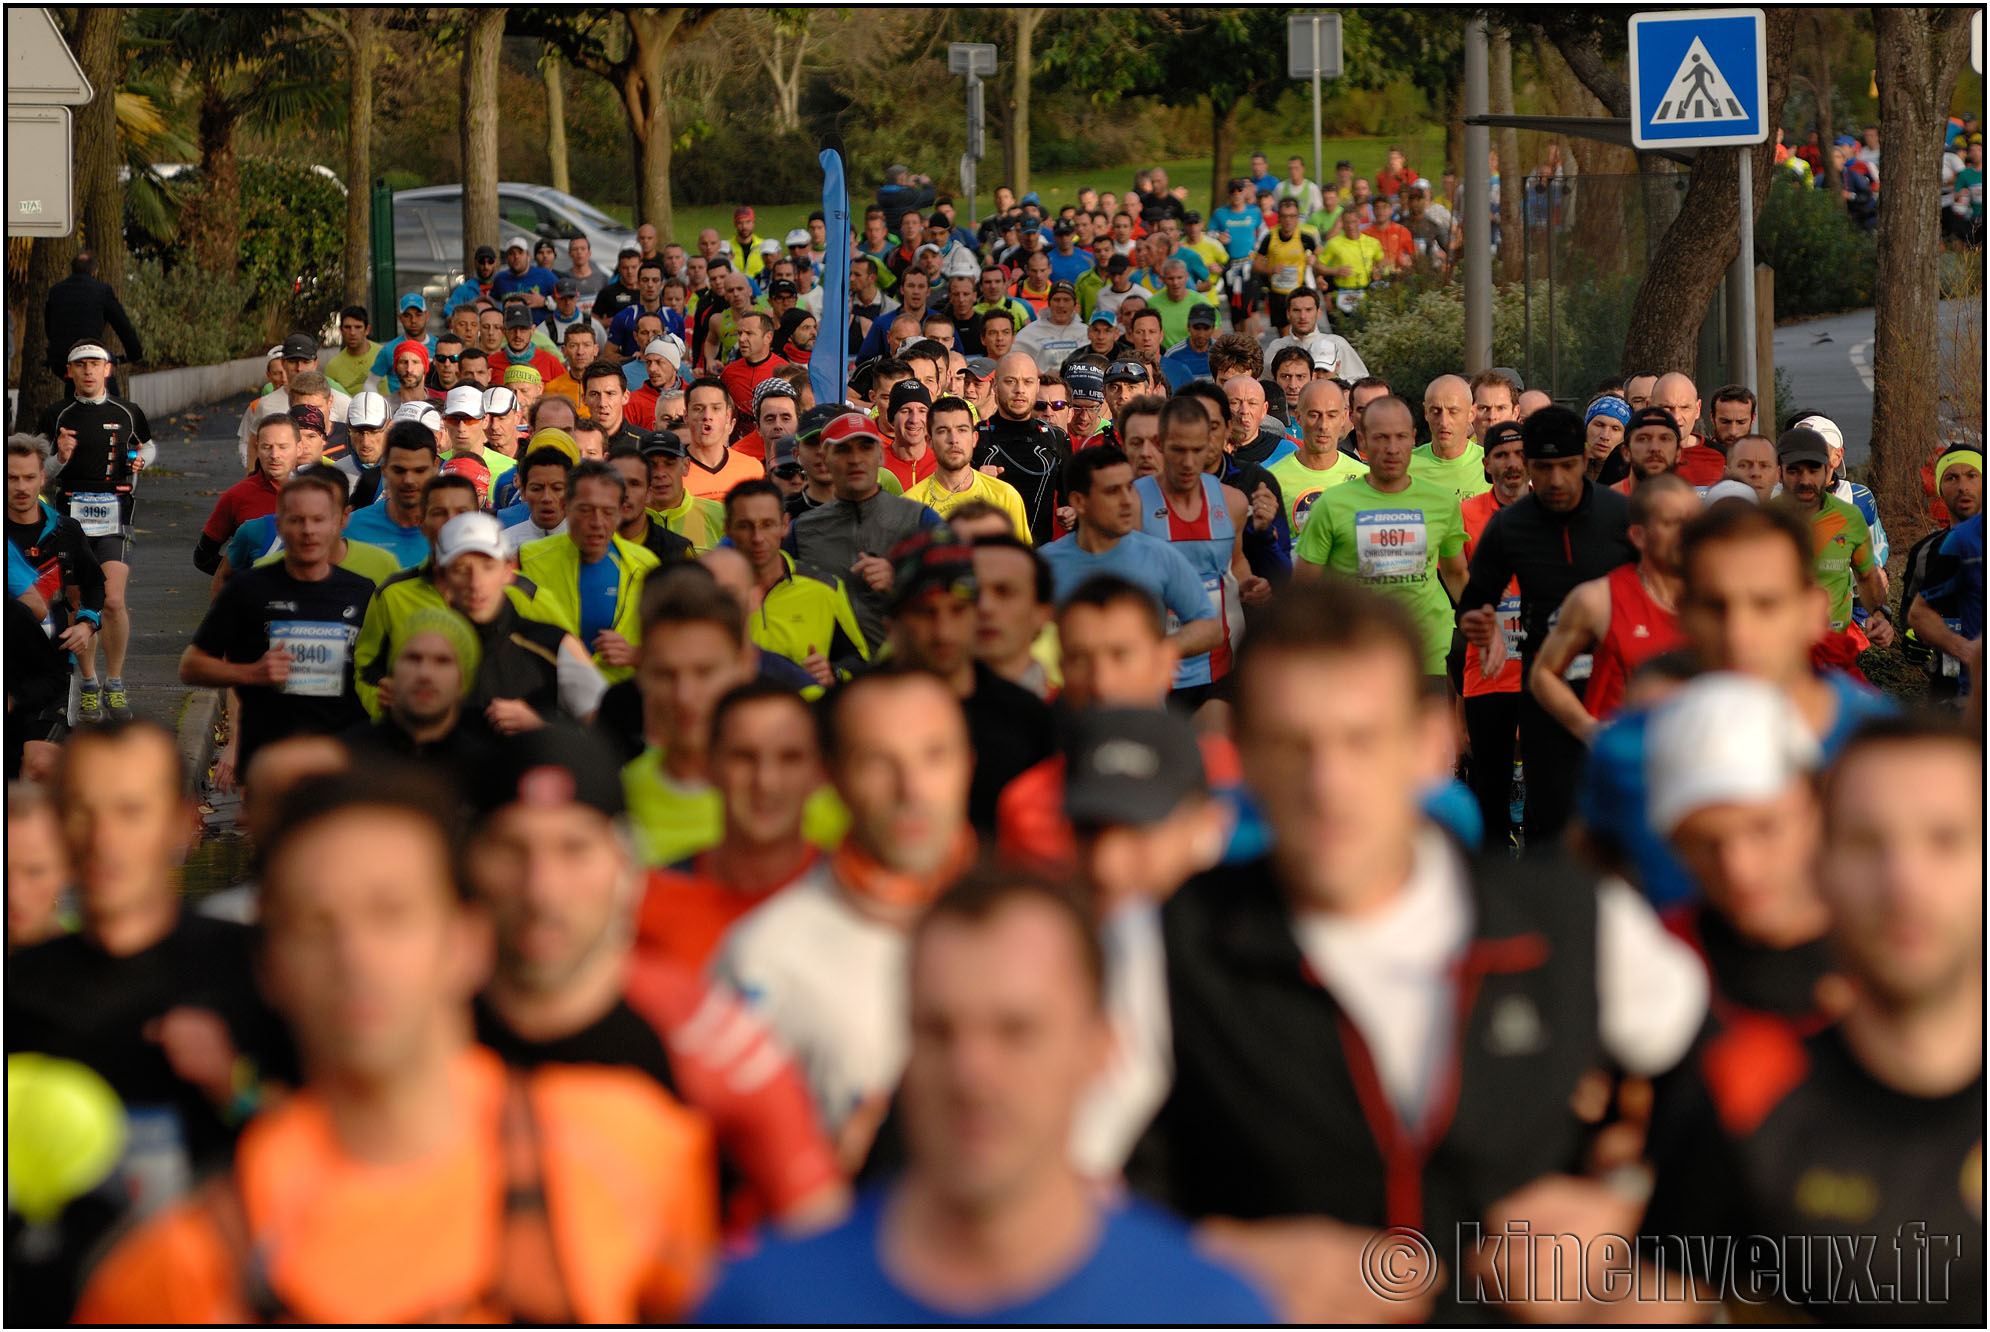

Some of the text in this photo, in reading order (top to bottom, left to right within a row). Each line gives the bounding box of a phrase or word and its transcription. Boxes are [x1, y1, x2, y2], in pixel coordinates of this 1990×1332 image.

[83, 506, 107, 517] 3196
[1374, 513, 1421, 521] BROOKS
[1380, 528, 1405, 547] 867
[1364, 549, 1402, 558] CHRISTOPHE
[289, 626, 341, 637] BROOKS
[289, 643, 326, 664] 1840
